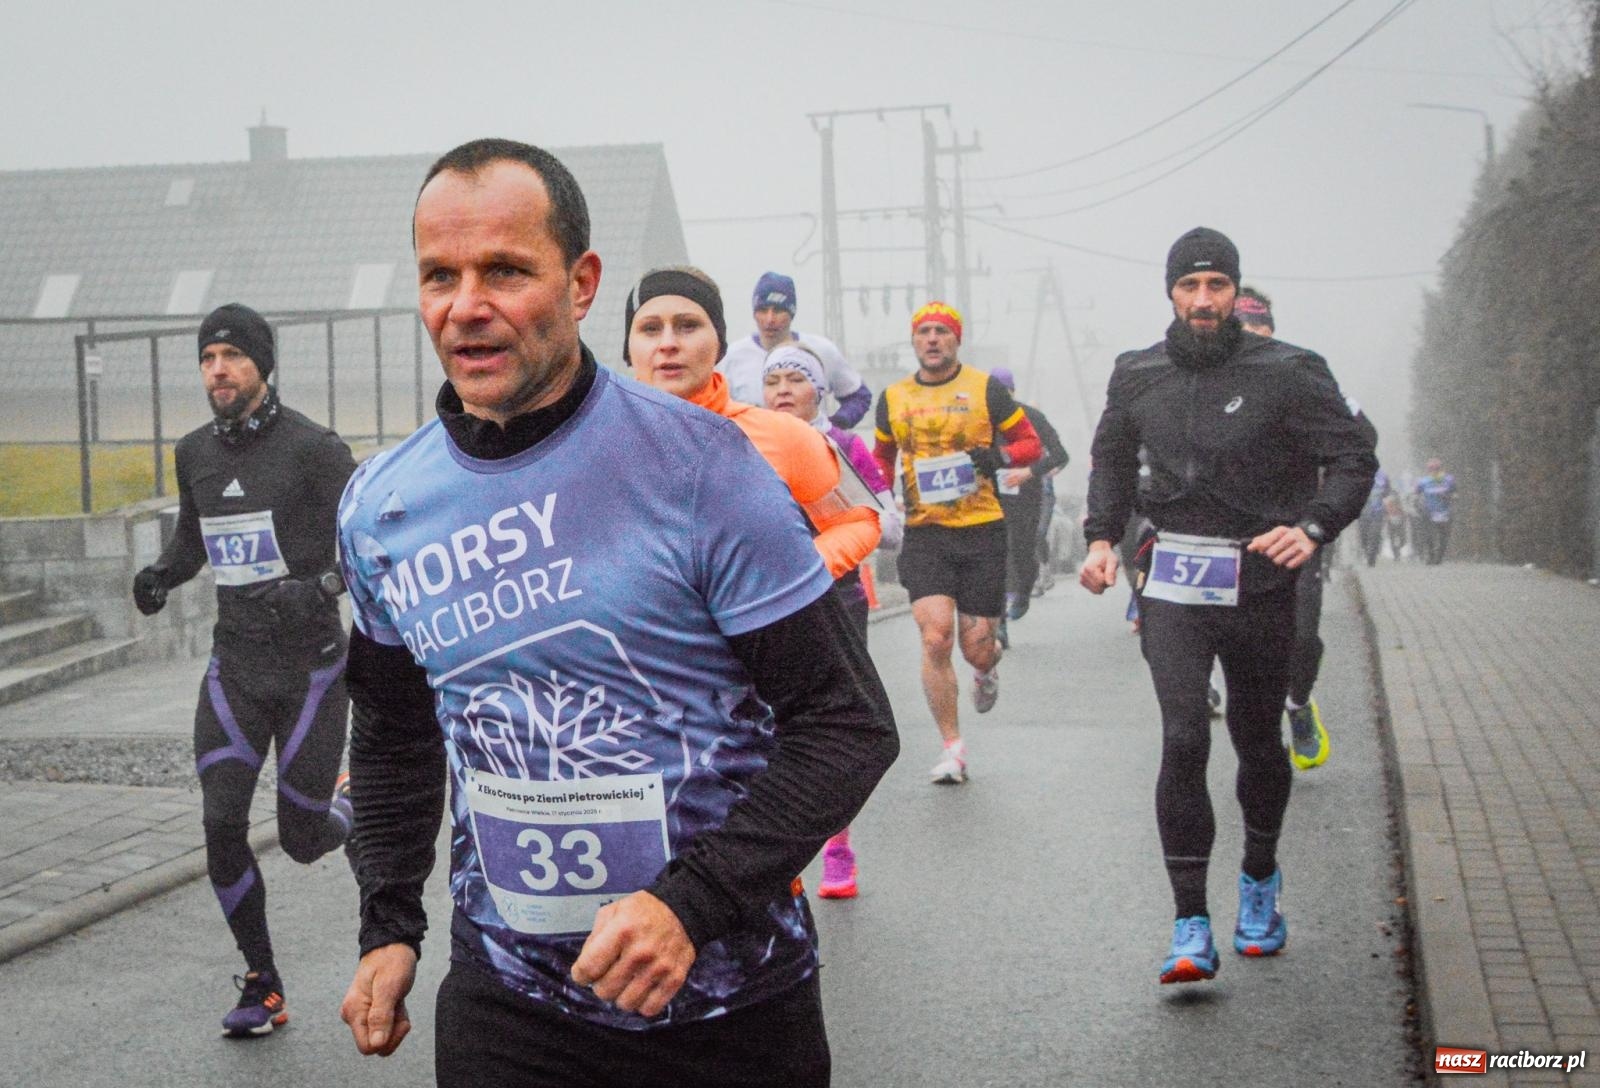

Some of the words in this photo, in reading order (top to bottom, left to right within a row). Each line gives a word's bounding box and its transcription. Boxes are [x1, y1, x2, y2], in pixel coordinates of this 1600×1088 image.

[931, 467, 960, 489] 44
[216, 533, 259, 564] 137
[381, 492, 557, 621] MORSY
[1172, 555, 1211, 585] 57
[402, 557, 583, 663] RACIBÓRZ
[478, 783, 483, 792] X
[484, 785, 496, 797] Eko
[497, 789, 521, 800] Cross
[523, 794, 535, 804] po
[537, 793, 567, 803] Ziemi
[568, 788, 644, 803] Pietrowickiej
[516, 828, 608, 891] 33
